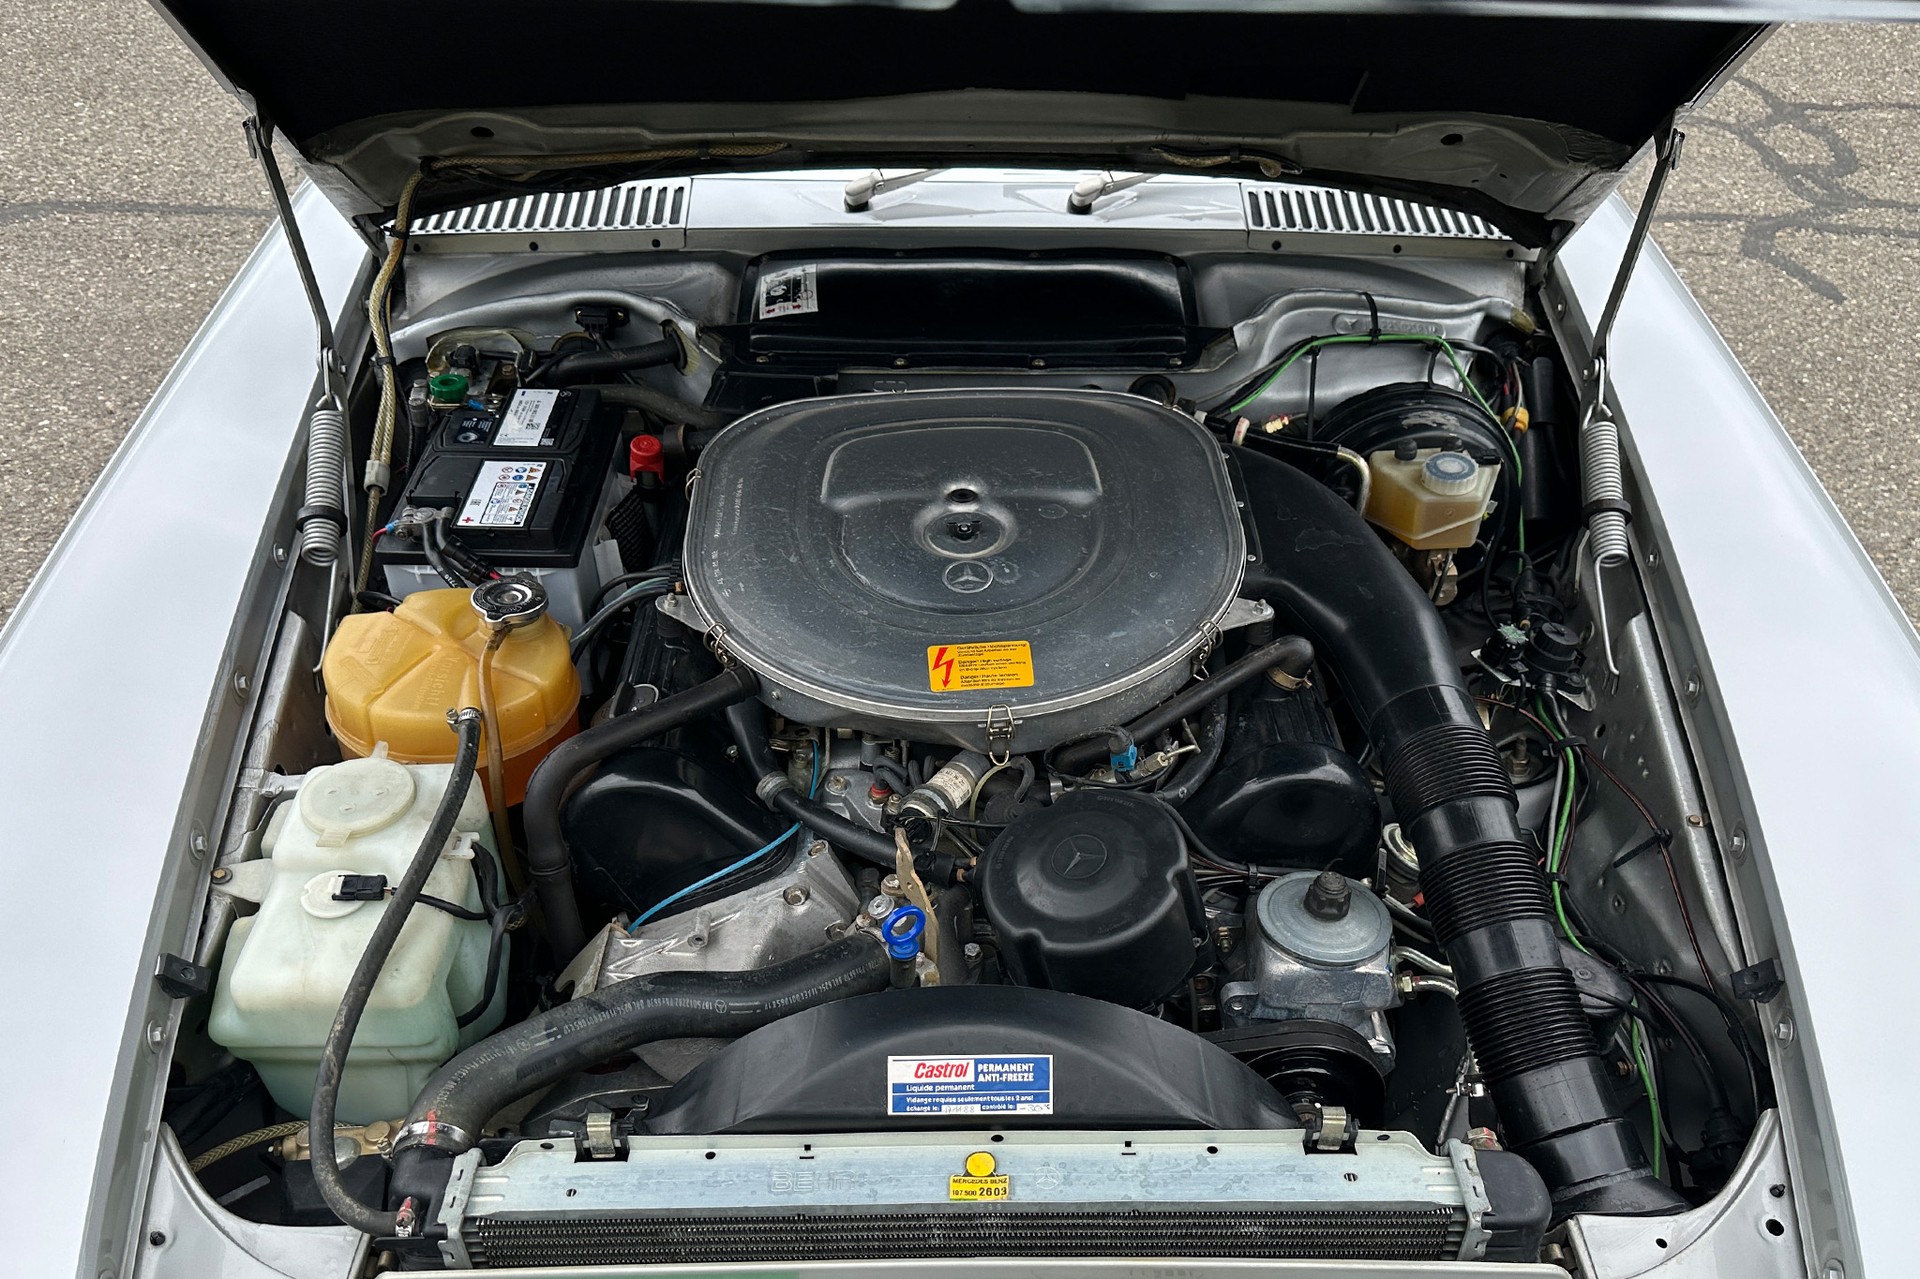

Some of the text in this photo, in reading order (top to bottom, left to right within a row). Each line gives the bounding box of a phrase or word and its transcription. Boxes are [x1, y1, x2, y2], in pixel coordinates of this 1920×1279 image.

[914, 1062, 970, 1079] Castrol
[977, 1063, 1035, 1073] PERMANENT
[977, 1073, 1034, 1082] ANTI-FREEZE
[906, 1084, 975, 1093] Liquide permanent
[979, 1187, 1007, 1196] 2603
